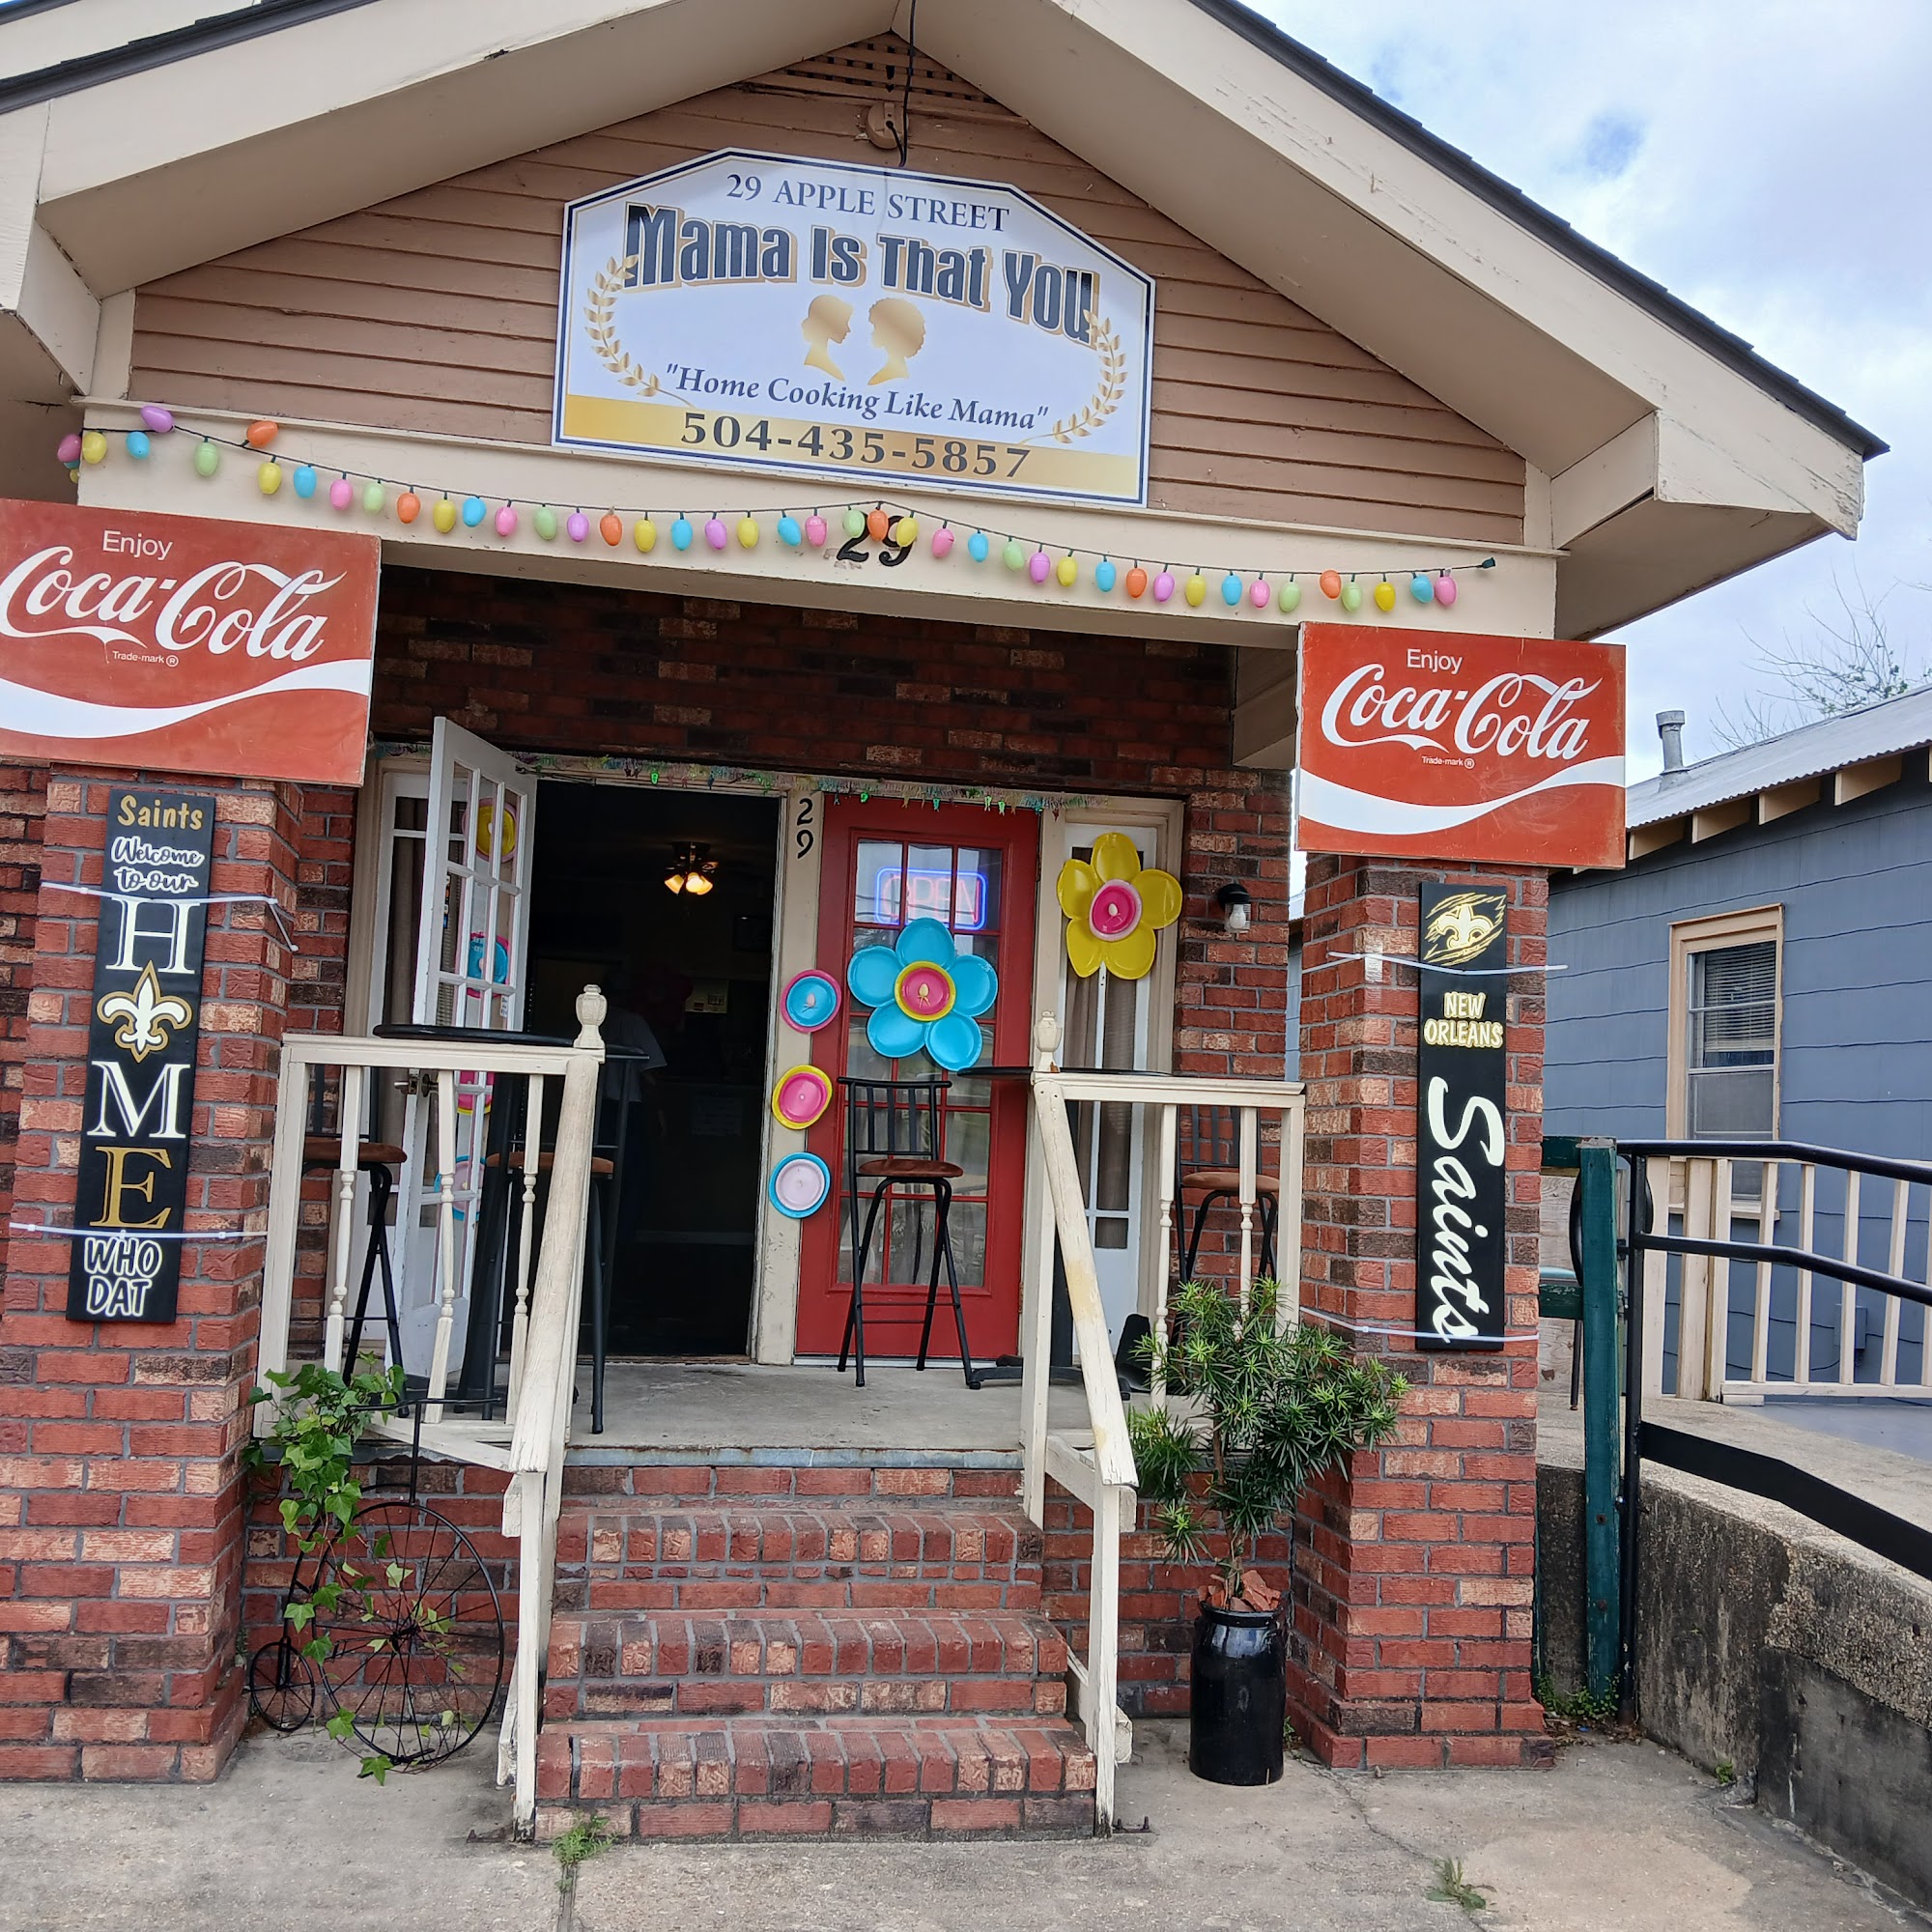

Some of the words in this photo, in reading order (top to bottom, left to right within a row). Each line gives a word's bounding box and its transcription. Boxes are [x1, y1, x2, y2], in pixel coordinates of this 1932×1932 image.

[725, 173, 762, 201] 29
[772, 180, 875, 215] APPLE
[887, 193, 1010, 232] STREET
[623, 201, 798, 293] Mama
[810, 225, 867, 288] Is
[876, 233, 993, 314] That
[666, 362, 760, 399] "Home
[767, 377, 880, 420] Cooking
[884, 390, 943, 419] Like
[948, 397, 1049, 430] Mama"
[680, 411, 1032, 479] 504-435-5857
[101, 529, 174, 561] Enjoy
[0, 545, 348, 662] Coca-Cola
[1406, 648, 1463, 674] Enjoy
[1321, 663, 1604, 760] Coca-Cola
[117, 794, 204, 831] Saints
[111, 836, 206, 867] Welcome
[113, 867, 146, 892] to
[146, 869, 199, 894] our
[882, 874, 980, 923] OPEN
[1443, 991, 1487, 1019] NEW
[1423, 1017, 1504, 1049] ORLEANS
[1427, 1075, 1505, 1344] Saints
[84, 1236, 163, 1280] WHO
[86, 1275, 153, 1318] DAT
